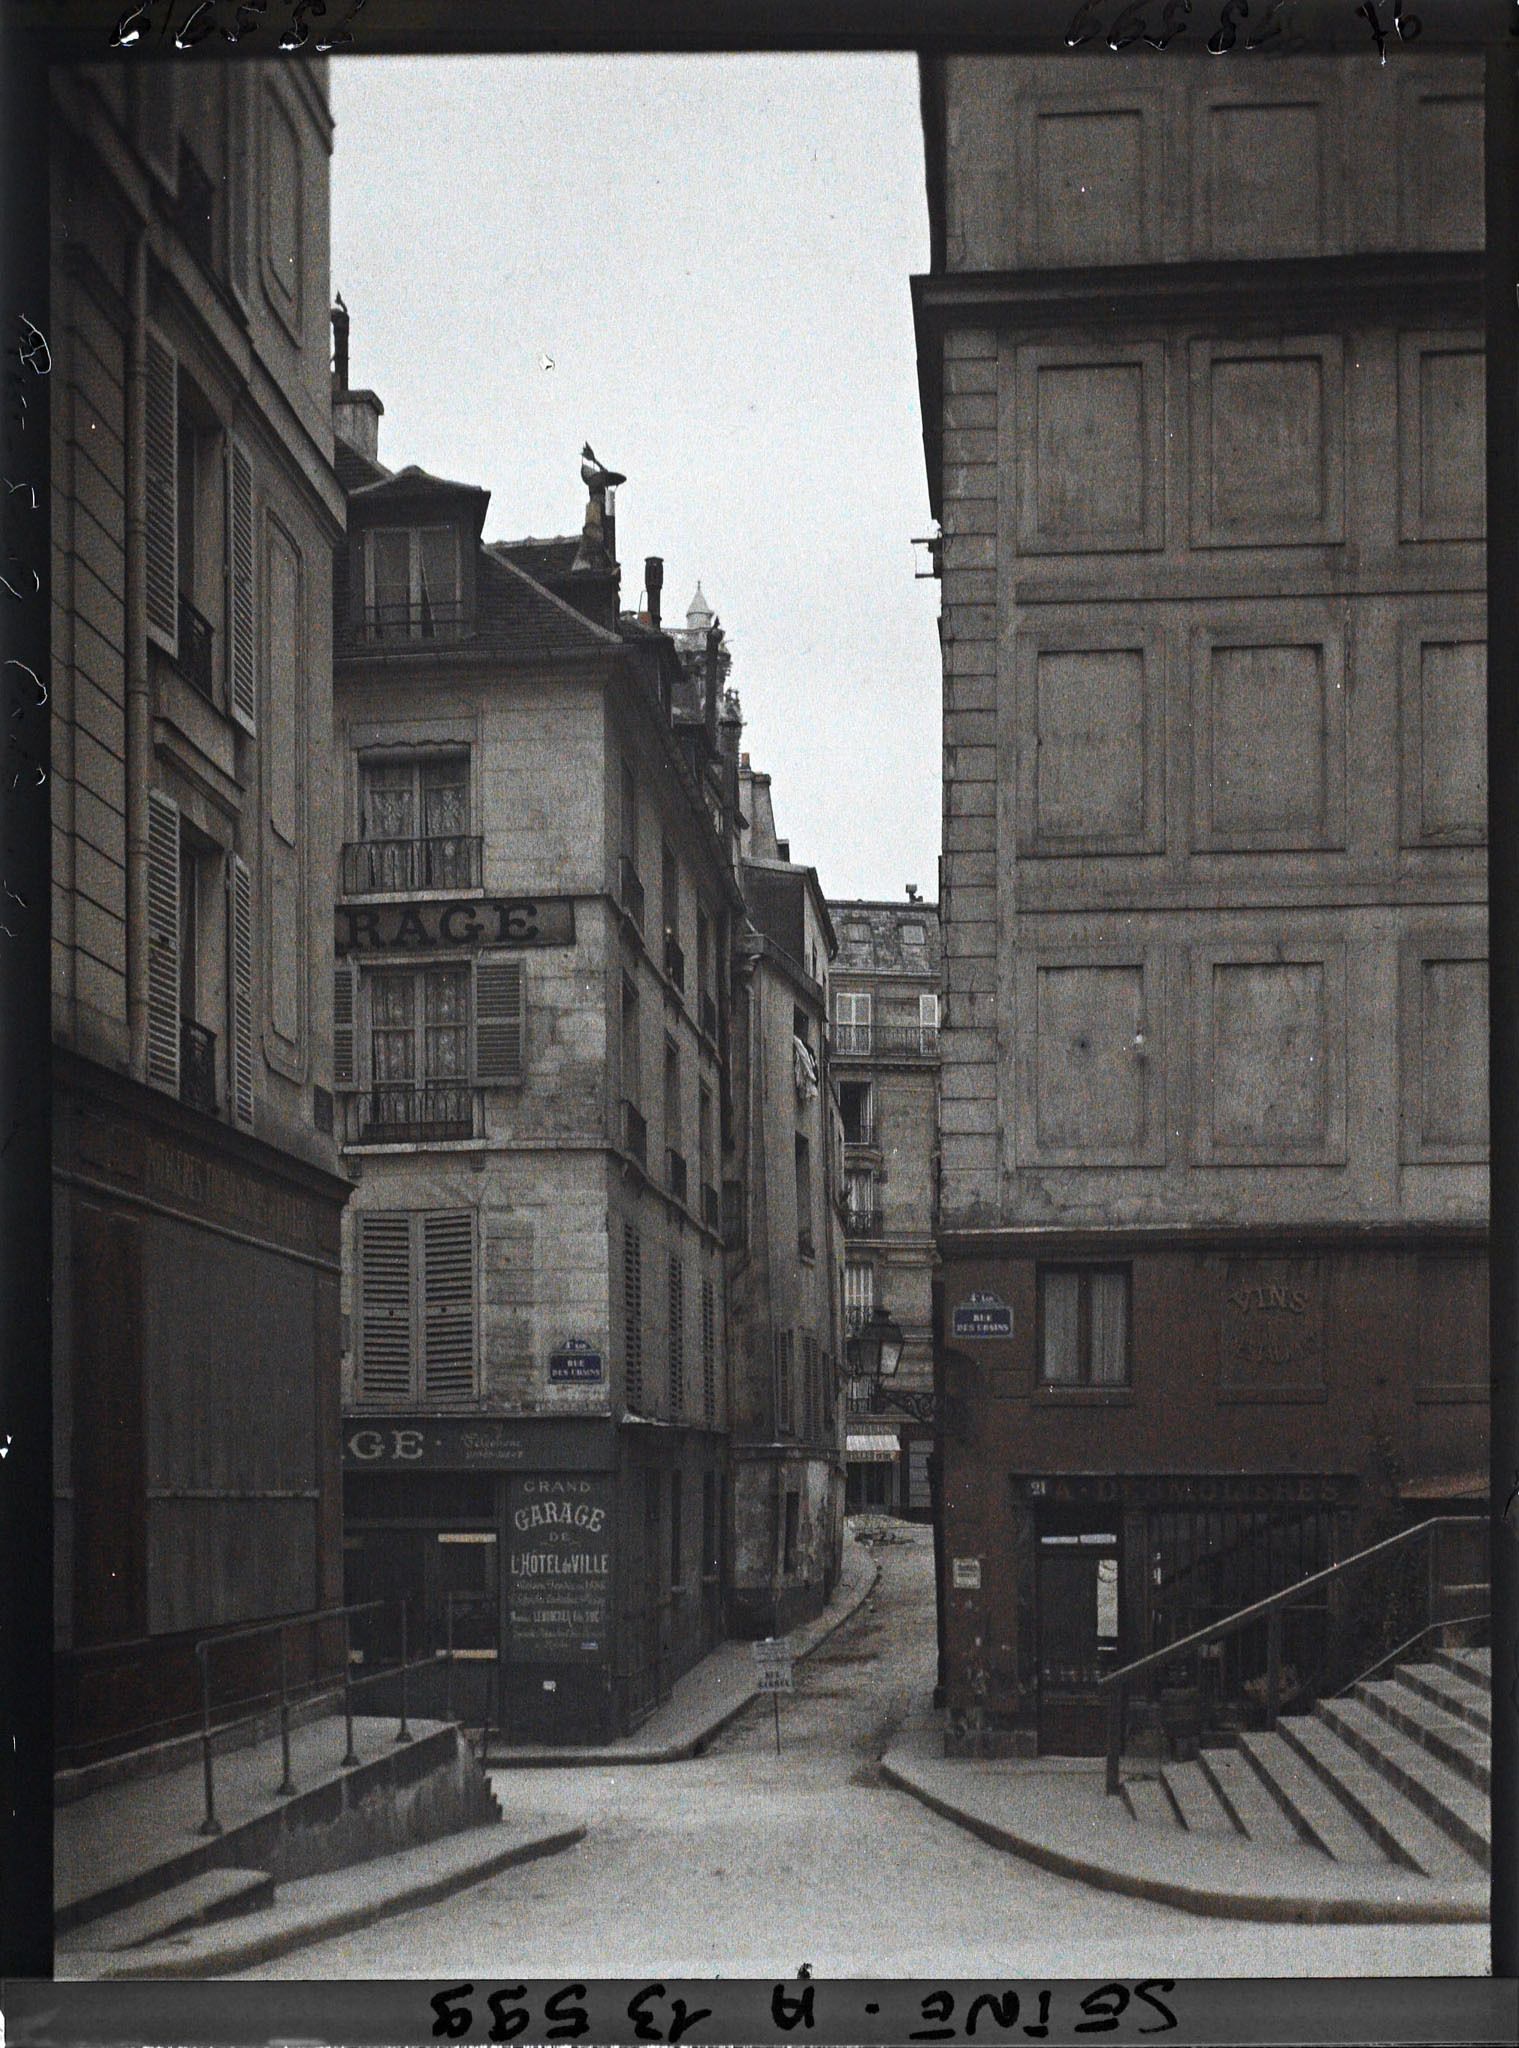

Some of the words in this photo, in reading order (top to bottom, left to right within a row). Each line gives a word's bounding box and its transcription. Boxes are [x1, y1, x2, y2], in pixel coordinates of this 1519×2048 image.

[342, 904, 539, 949] RAGE
[1228, 1284, 1309, 1315] VINS
[972, 1313, 993, 1322] RUE
[956, 1324, 975, 1332] DES
[523, 1480, 592, 1493] GRAND
[1030, 1481, 1047, 1496] 21
[514, 1501, 606, 1532] GARAGE
[549, 1532, 571, 1542] DE
[571, 1553, 609, 1574] VILLE
